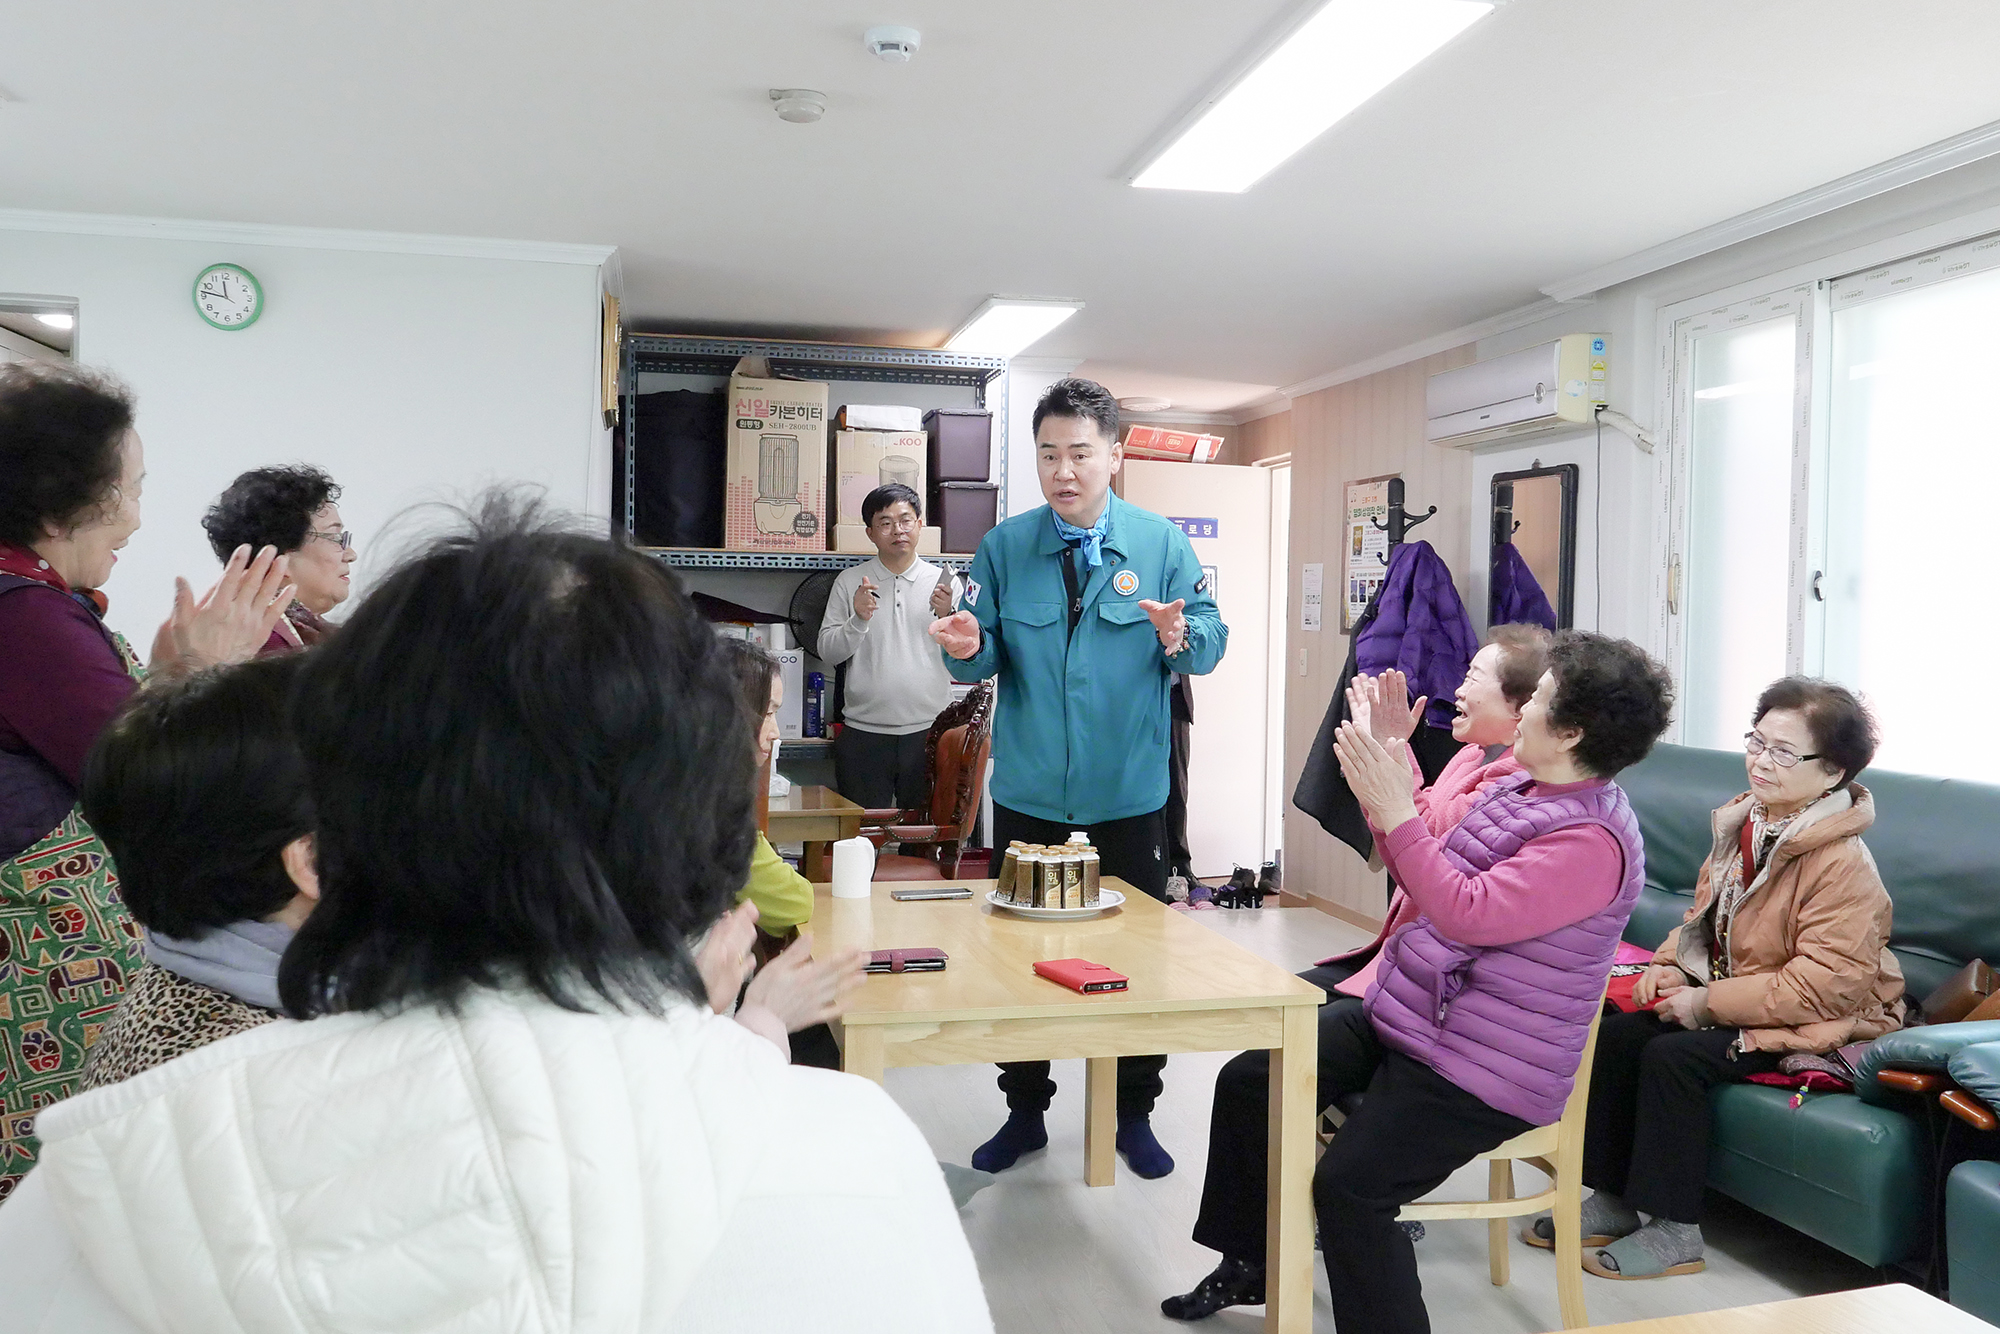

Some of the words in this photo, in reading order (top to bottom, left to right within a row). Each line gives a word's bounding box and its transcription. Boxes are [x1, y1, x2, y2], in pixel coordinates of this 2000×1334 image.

[736, 399, 769, 418] 신일
[770, 405, 823, 421] 카본히터
[769, 422, 817, 430] SEH-2800UB
